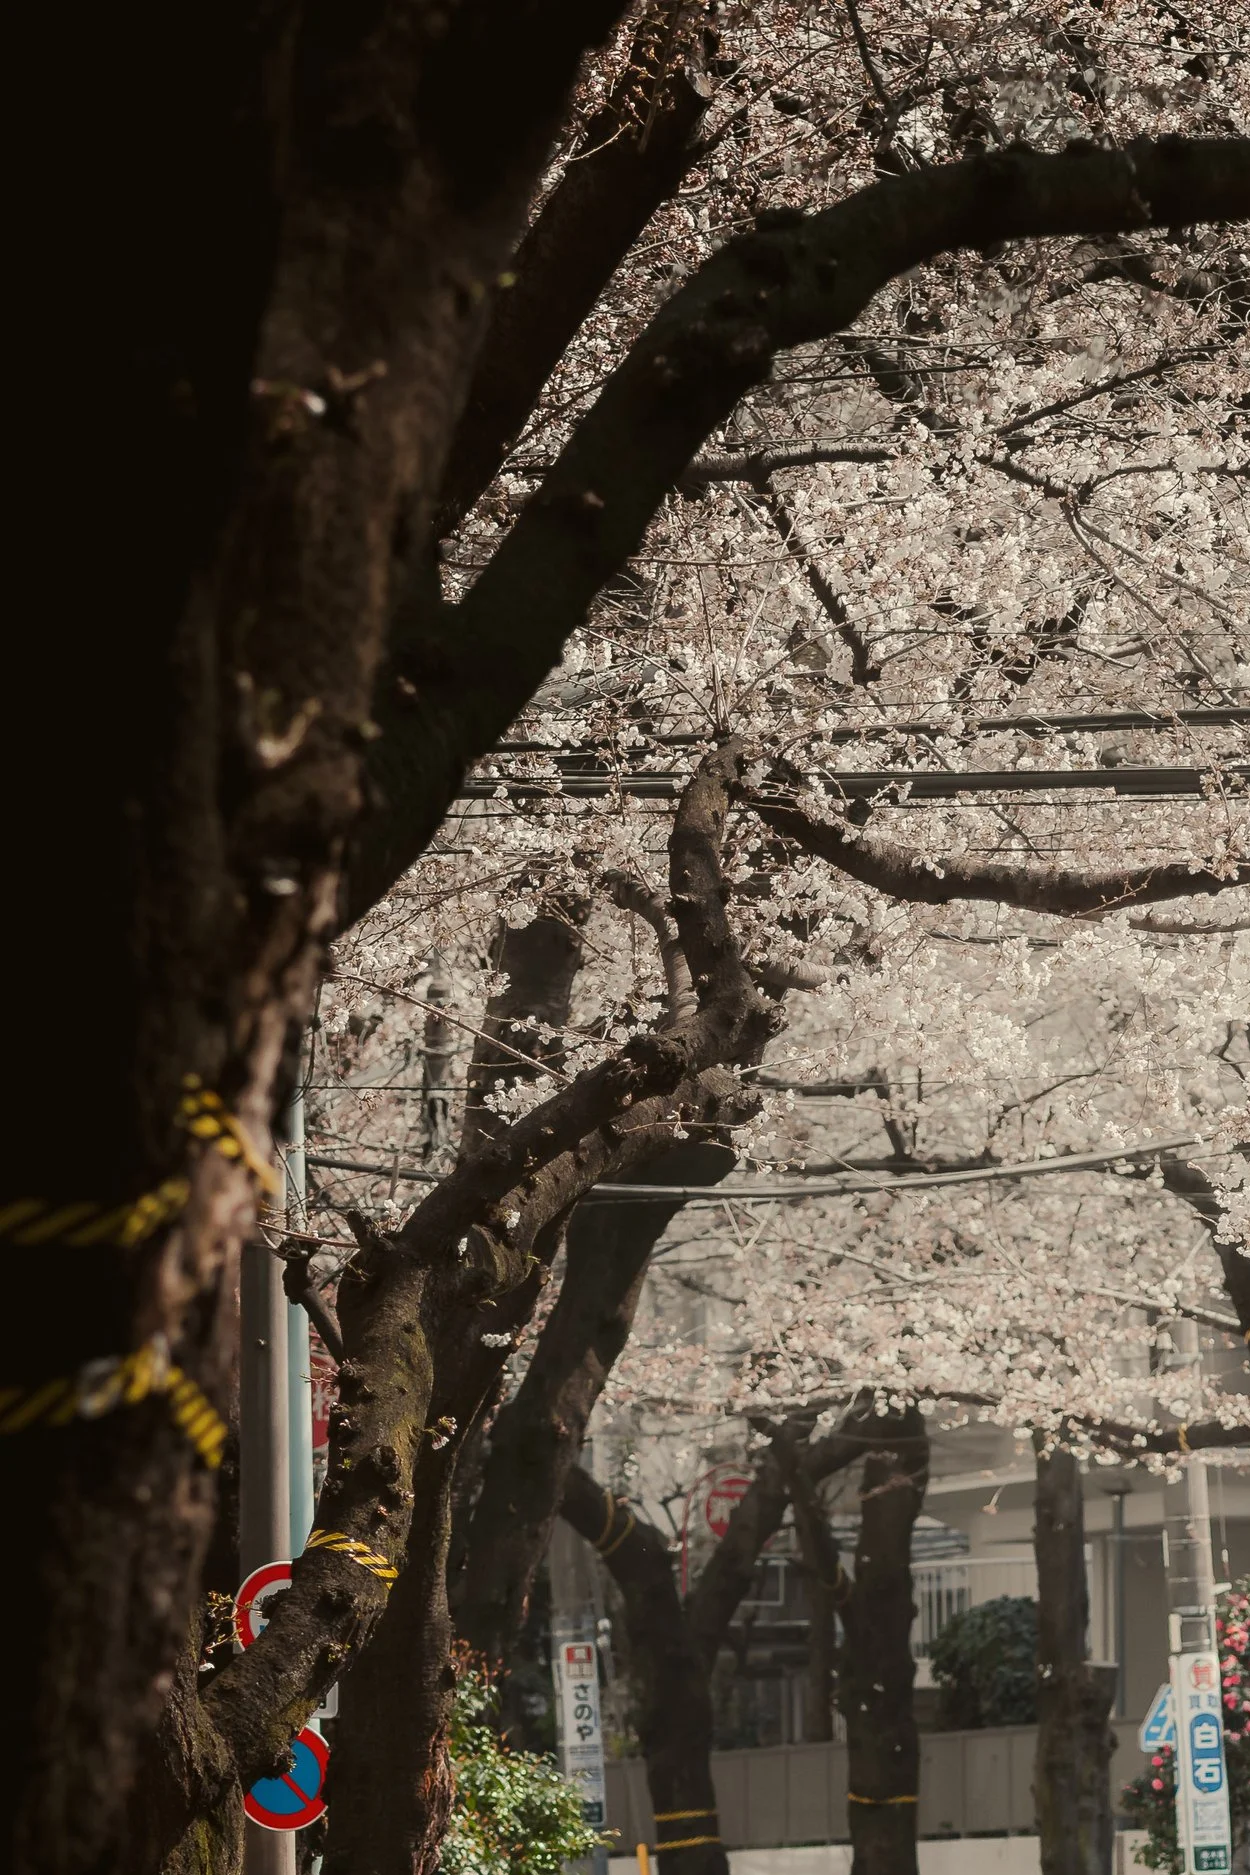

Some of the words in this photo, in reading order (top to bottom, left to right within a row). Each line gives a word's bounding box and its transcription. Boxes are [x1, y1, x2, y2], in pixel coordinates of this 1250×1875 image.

[573, 1683, 594, 1742] さのや
[1194, 1722, 1221, 1784] 白石
